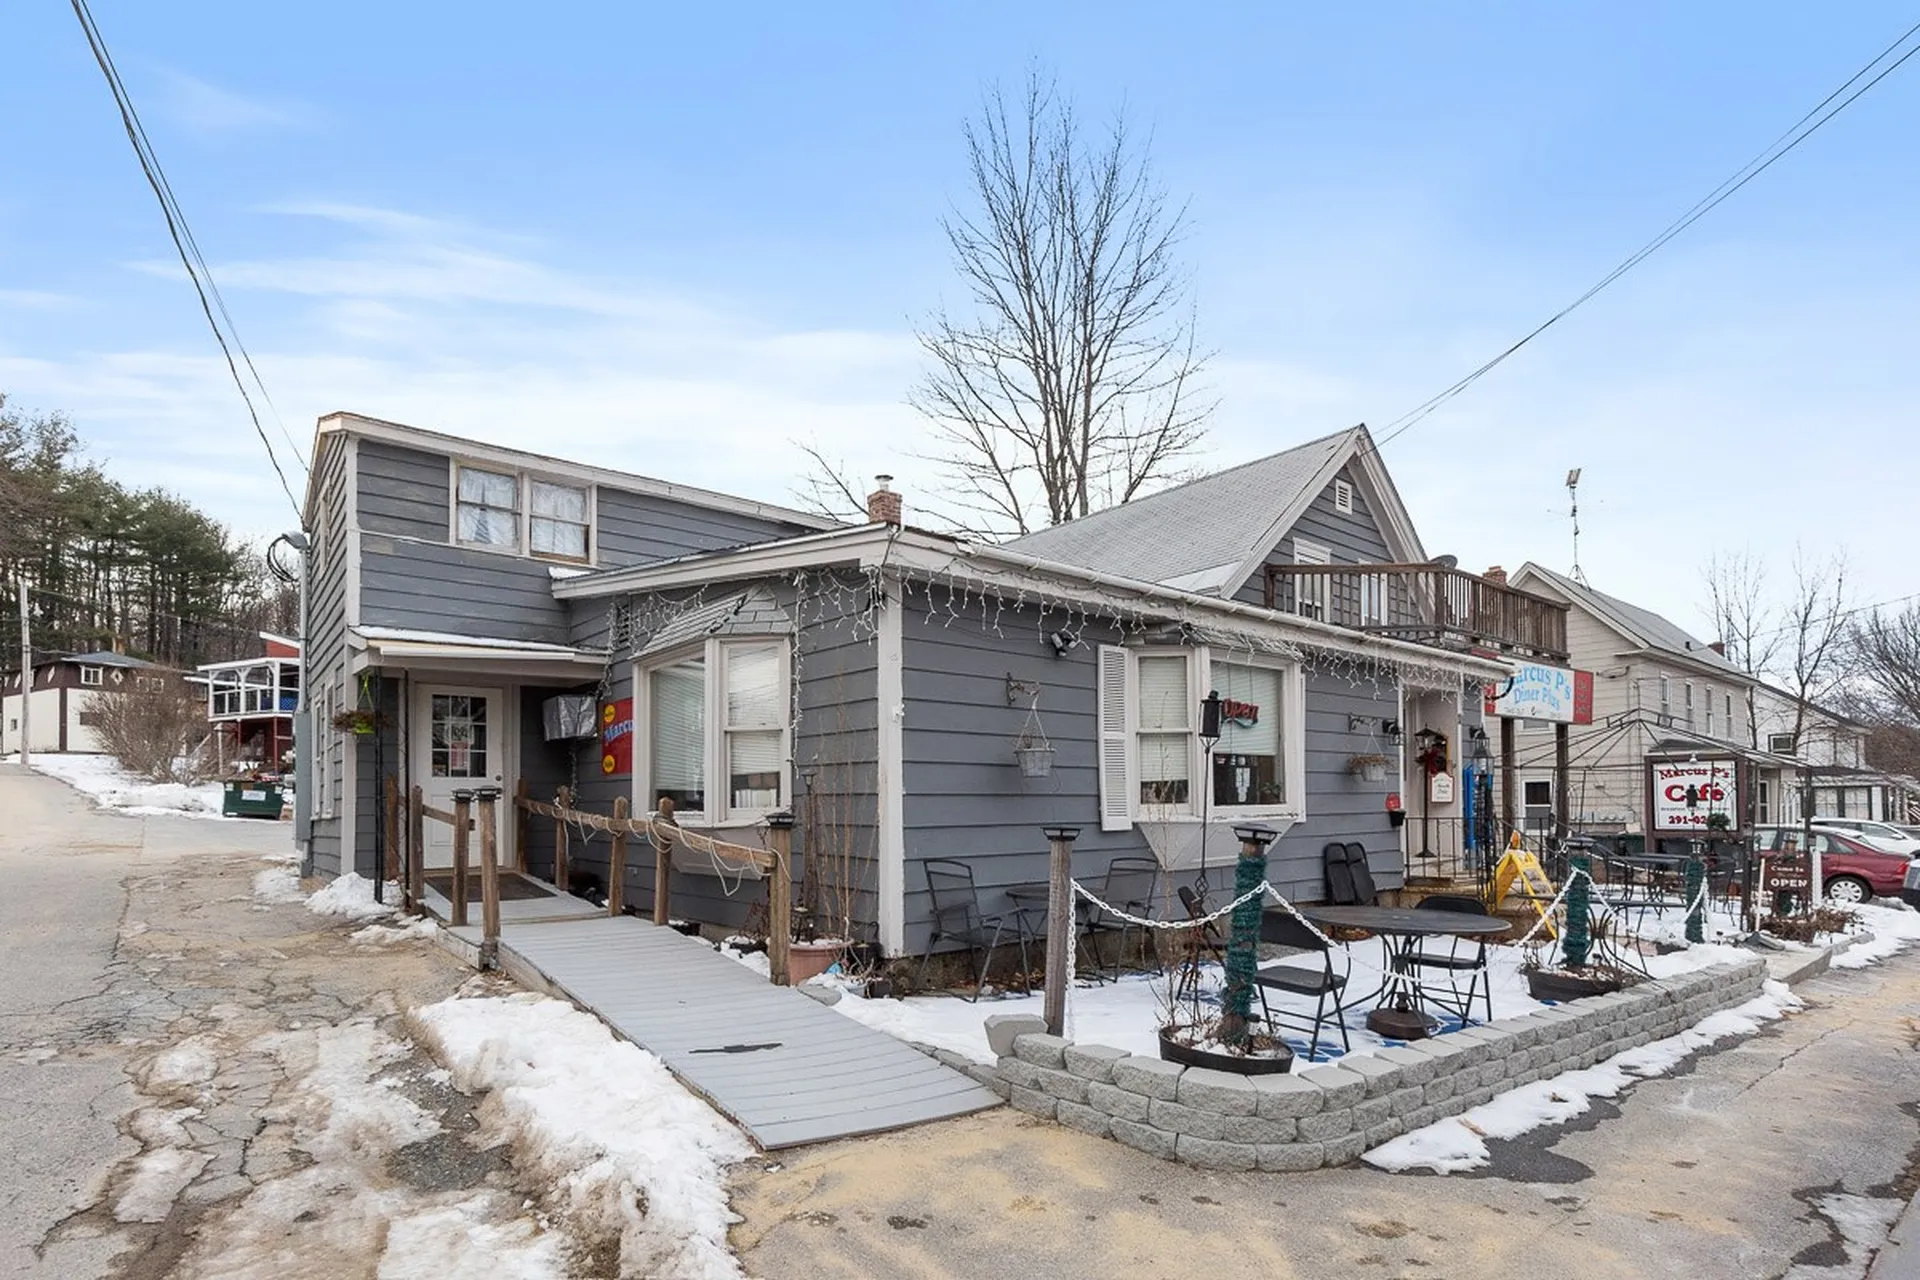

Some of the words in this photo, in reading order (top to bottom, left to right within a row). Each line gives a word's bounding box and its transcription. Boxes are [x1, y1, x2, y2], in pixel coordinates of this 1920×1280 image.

[1514, 687, 1539, 704] Diner
[1660, 768, 1708, 780] Marcus
[1665, 782, 1724, 802] Cfé
[1770, 878, 1807, 887] OPEN
